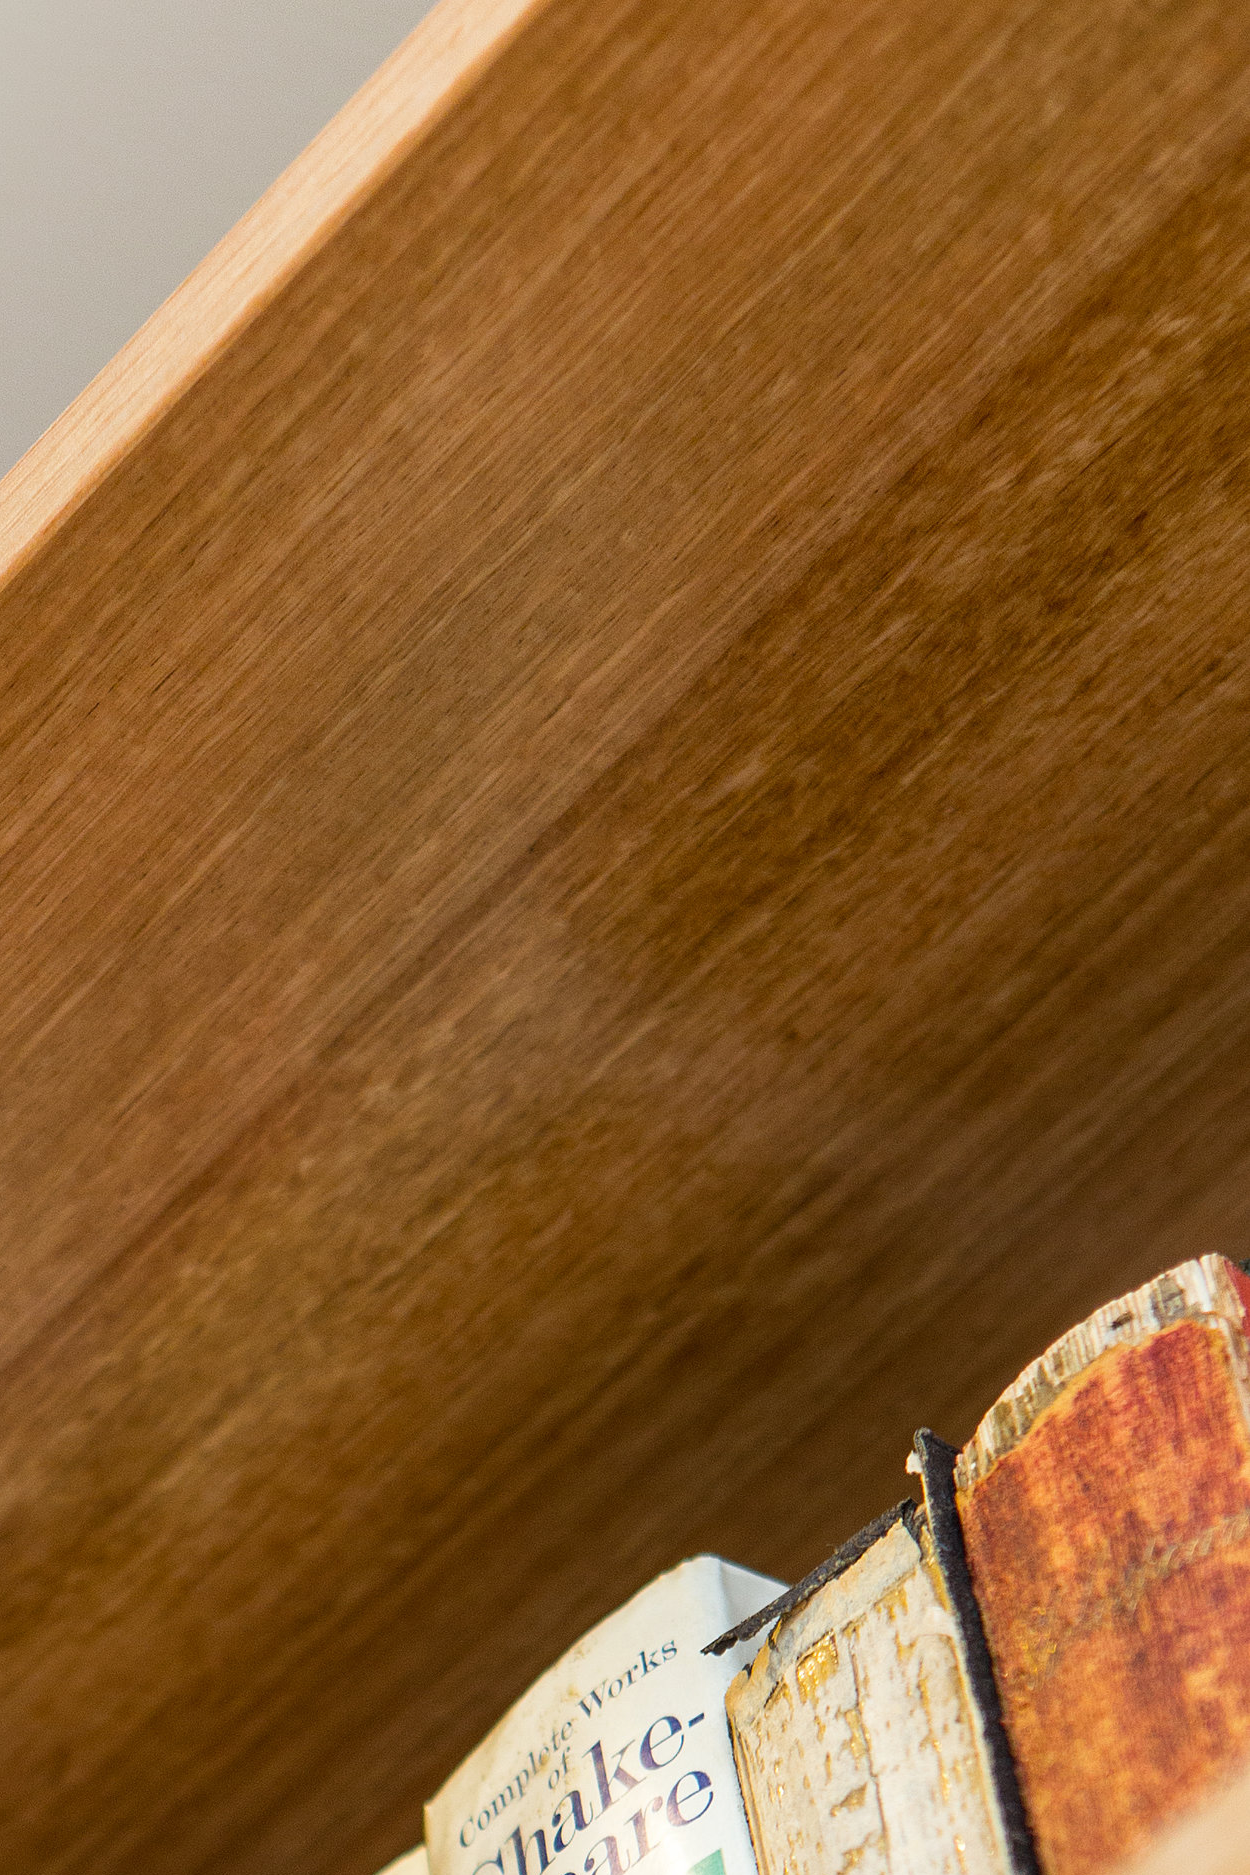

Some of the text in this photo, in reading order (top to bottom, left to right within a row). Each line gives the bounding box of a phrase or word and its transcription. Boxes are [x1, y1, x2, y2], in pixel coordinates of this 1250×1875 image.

[457, 1637, 679, 1849] Complete Works
[547, 1746, 571, 1791] of
